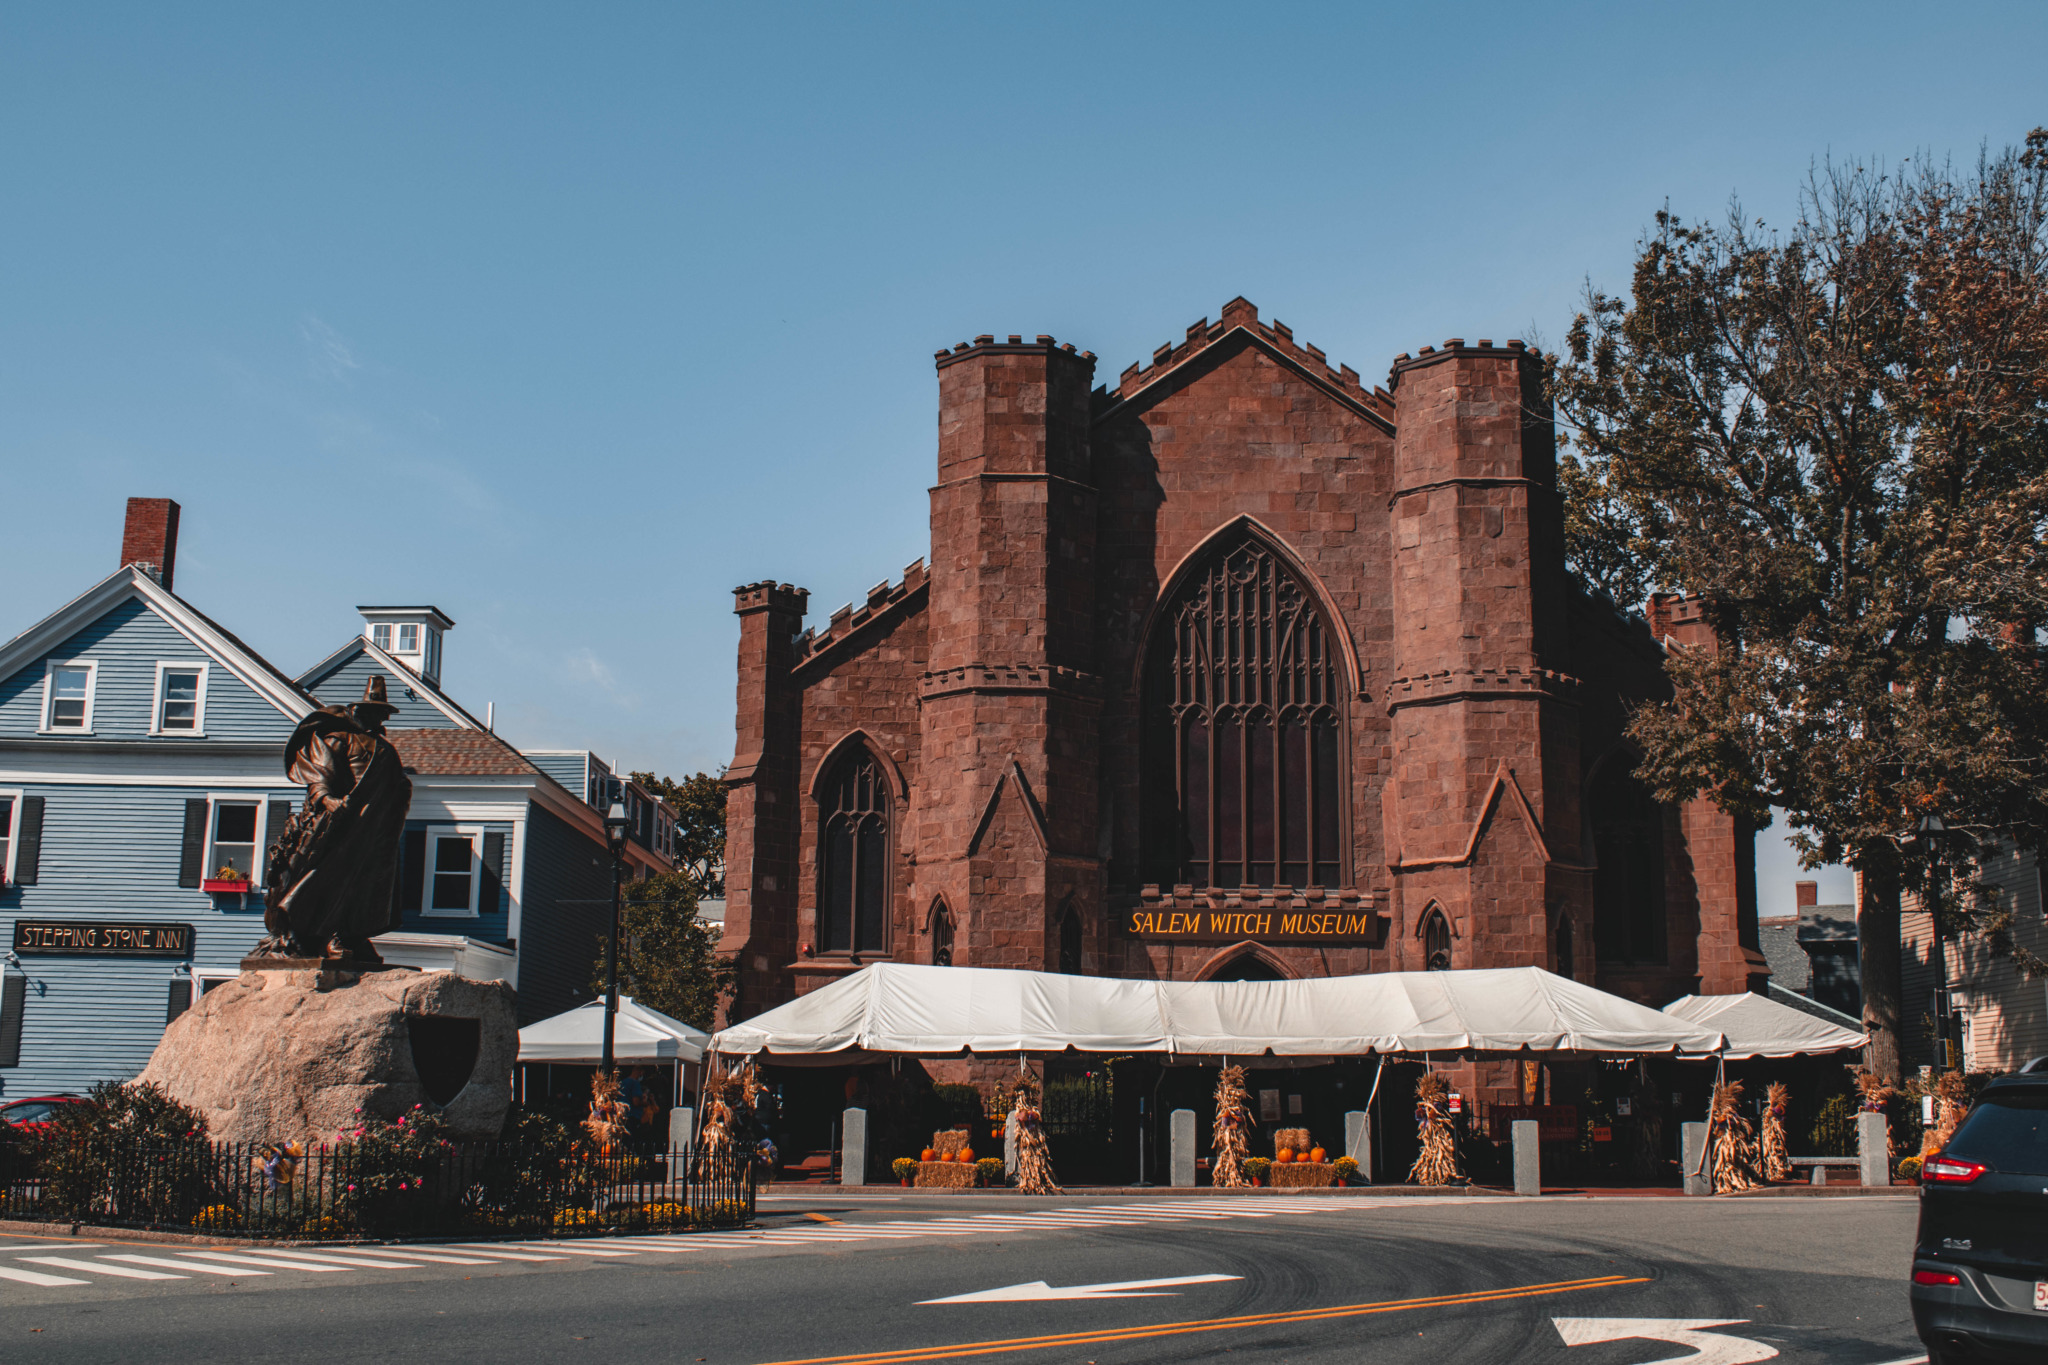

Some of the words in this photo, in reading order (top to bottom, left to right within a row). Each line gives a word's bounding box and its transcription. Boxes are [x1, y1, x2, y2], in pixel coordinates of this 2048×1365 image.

[1129, 912, 1201, 934] SALEM
[1210, 913, 1272, 934] WITCH
[1279, 914, 1367, 935] MUSEUM
[22, 928, 97, 947] STEPPING
[101, 929, 151, 948] STONE
[155, 930, 182, 948] INN
